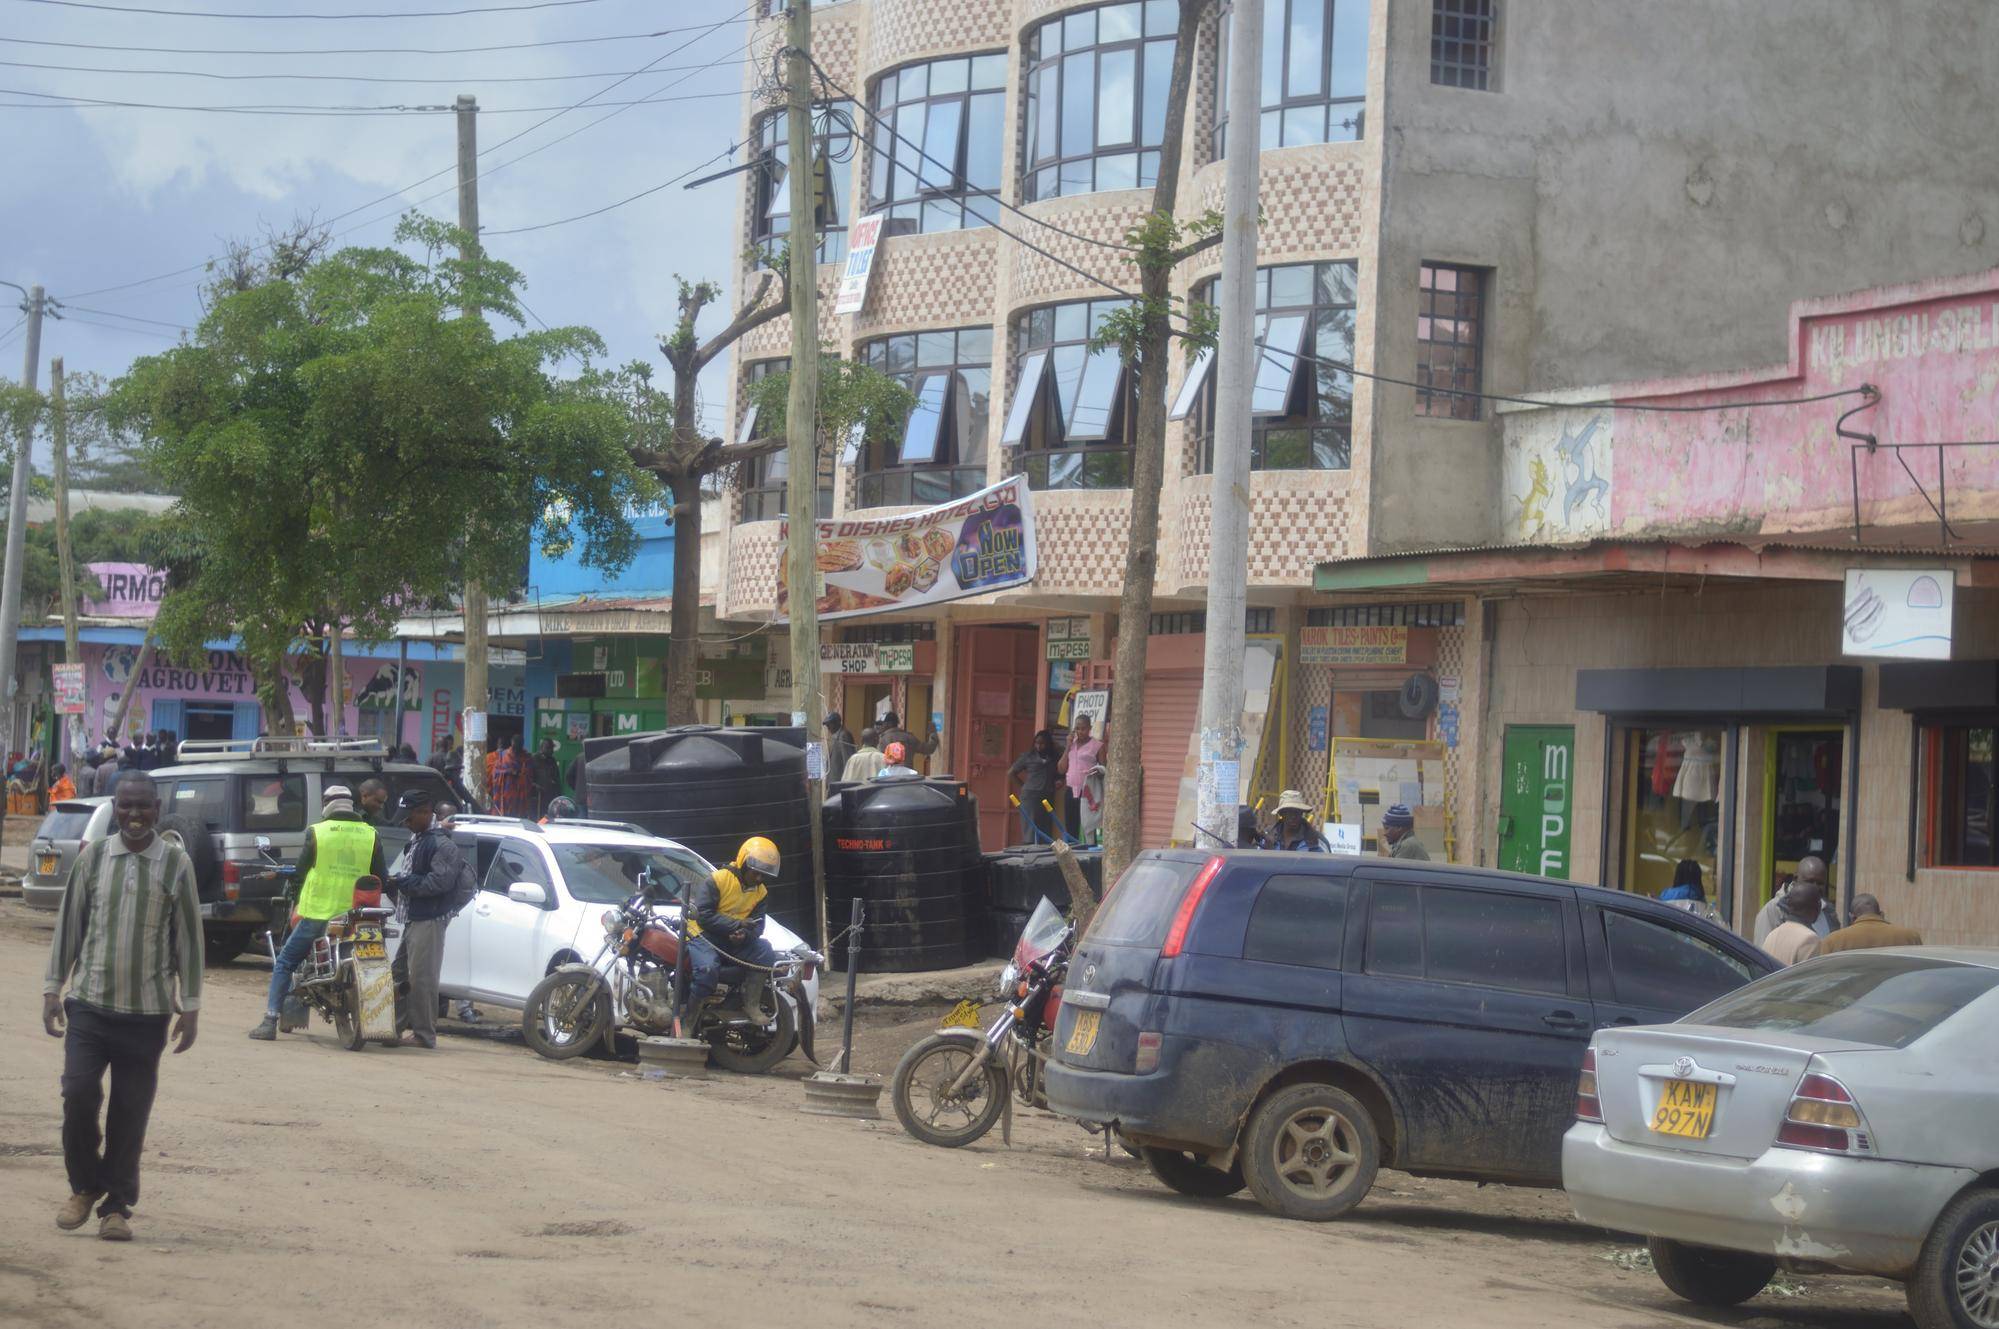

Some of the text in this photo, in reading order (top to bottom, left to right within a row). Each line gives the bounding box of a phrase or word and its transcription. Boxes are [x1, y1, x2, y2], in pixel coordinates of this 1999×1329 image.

[838, 517, 916, 537] DISHES
[921, 500, 980, 528] HOTEL
[983, 487, 1016, 511] LTD
[775, 669, 793, 688] AGR
[842, 660, 867, 672] SHOP
[136, 668, 247, 694] AGROVET
[1077, 694, 1105, 708] PHOTO
[1667, 1081, 1706, 1108] KAW
[1654, 1106, 1708, 1137] 997N
